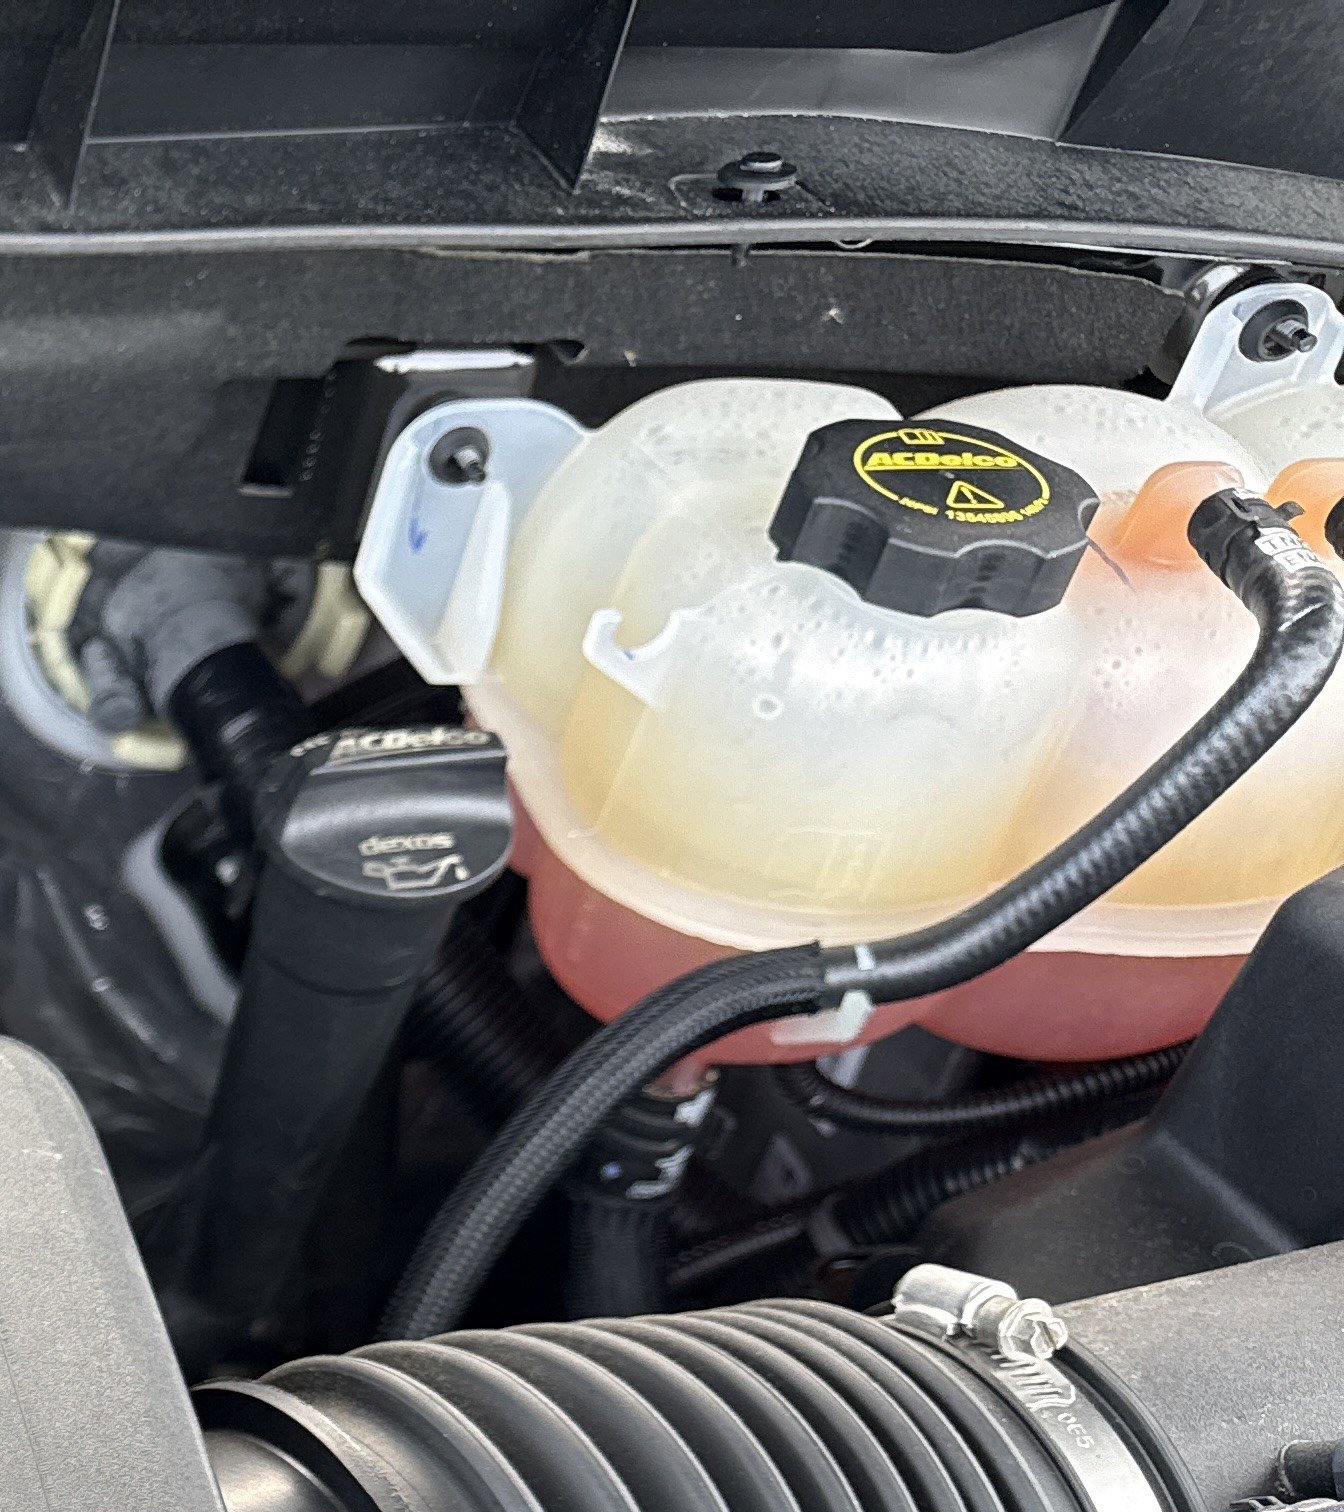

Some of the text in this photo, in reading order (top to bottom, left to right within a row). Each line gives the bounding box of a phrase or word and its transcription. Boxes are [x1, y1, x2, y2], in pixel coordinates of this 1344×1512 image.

[865, 452, 1018, 468] ACDelco
[330, 727, 490, 762] ACDelco
[359, 832, 455, 856] dexos
